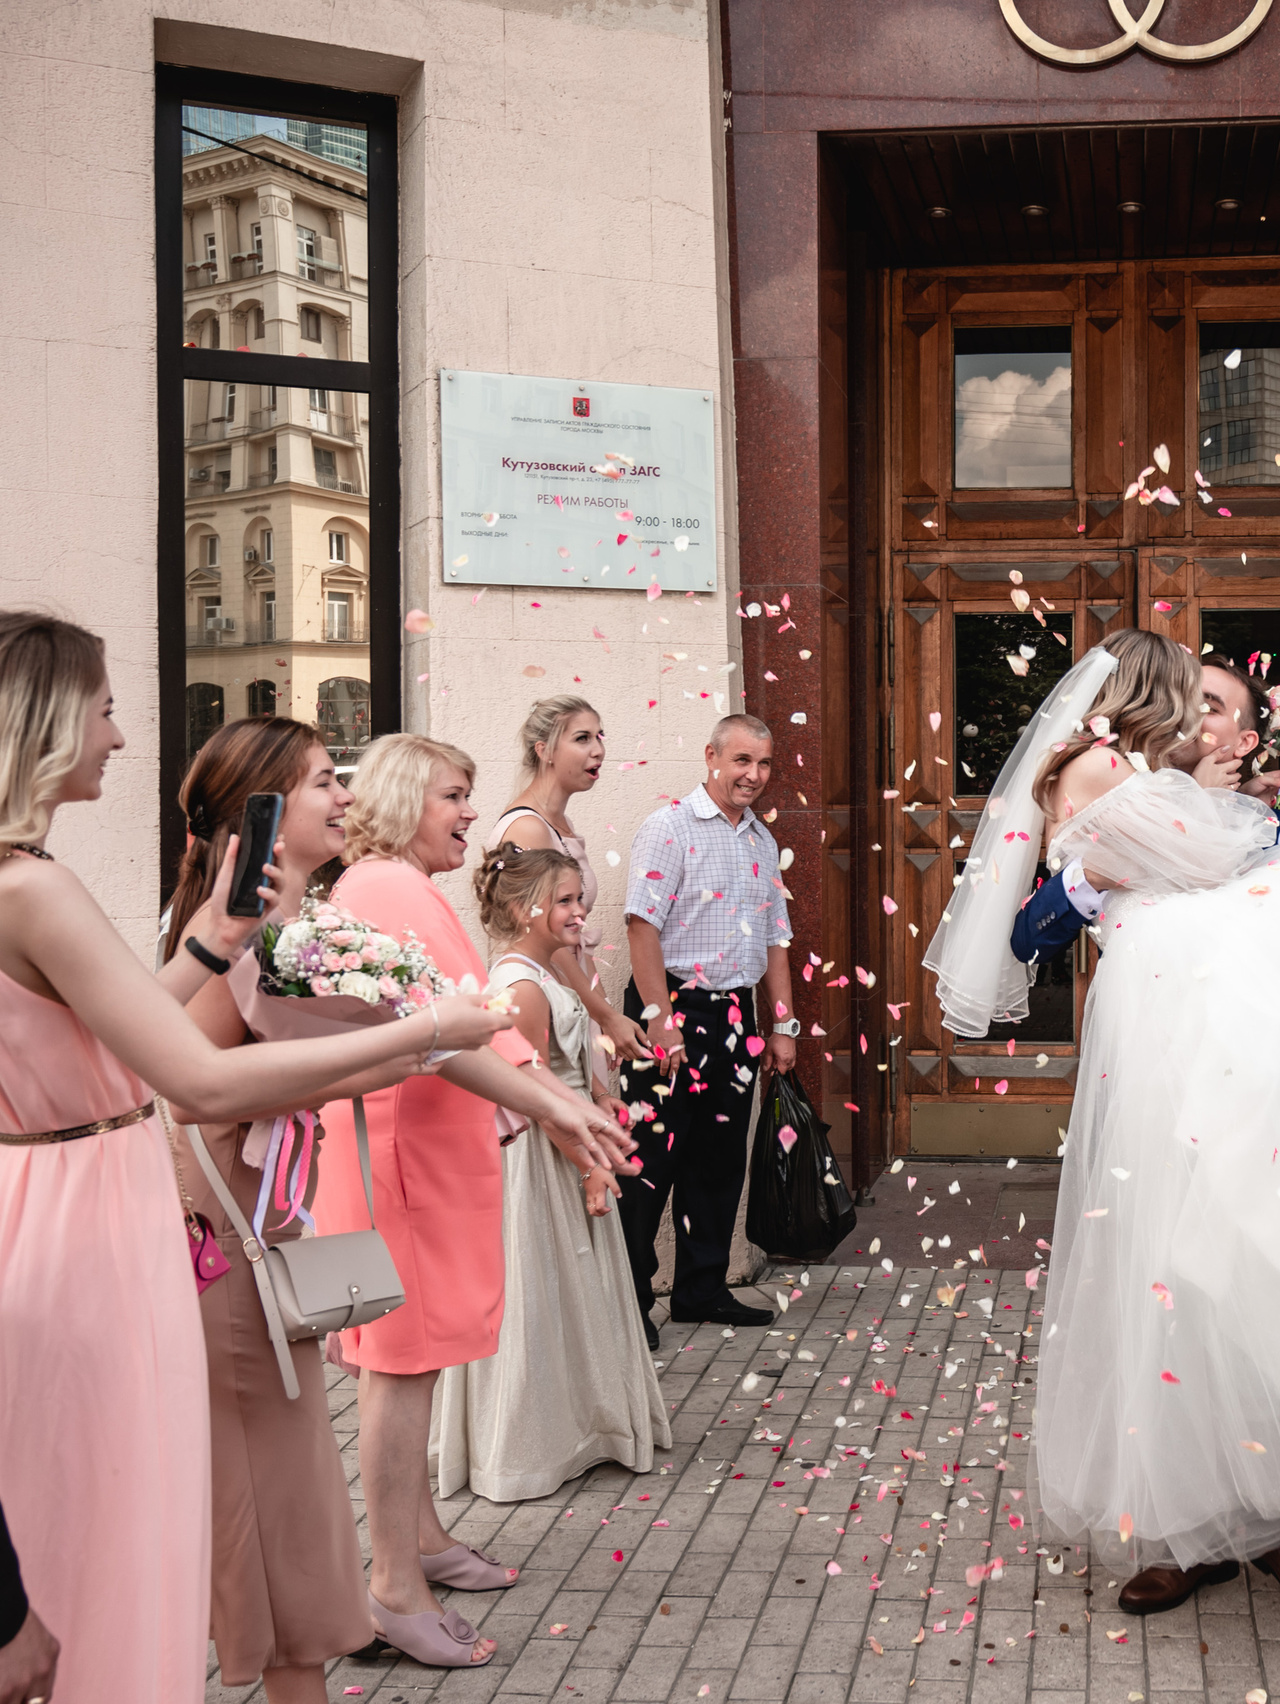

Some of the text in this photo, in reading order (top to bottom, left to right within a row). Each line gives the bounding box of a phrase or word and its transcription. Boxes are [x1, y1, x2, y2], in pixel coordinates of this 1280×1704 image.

[502, 457, 586, 472] Кутузовский
[630, 465, 661, 478] ЗАГС
[584, 497, 628, 508] РАБОТЫ
[635, 516, 660, 527] 9:00
[671, 518, 700, 529] 18:00
